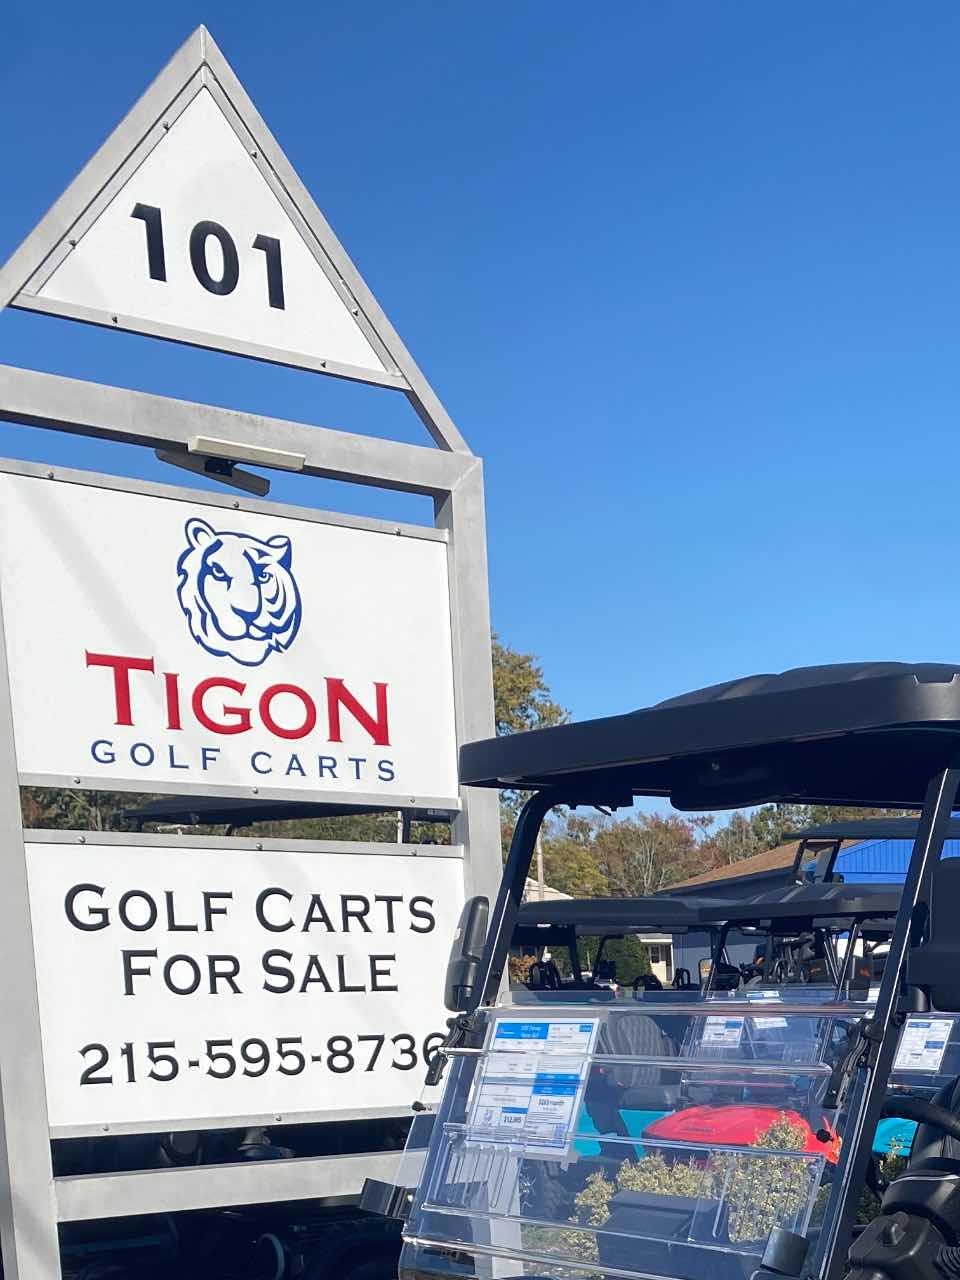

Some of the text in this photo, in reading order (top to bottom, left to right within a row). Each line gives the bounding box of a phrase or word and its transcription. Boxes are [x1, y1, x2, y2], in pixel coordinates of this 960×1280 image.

[130, 202, 286, 311] 101
[85, 649, 391, 747] TIGON
[90, 739, 395, 782] GOLF CARTS
[64, 883, 436, 934] GOLF CARTS
[121, 948, 399, 996] FOR SALE
[78, 1032, 446, 1086] 215-595-8736
